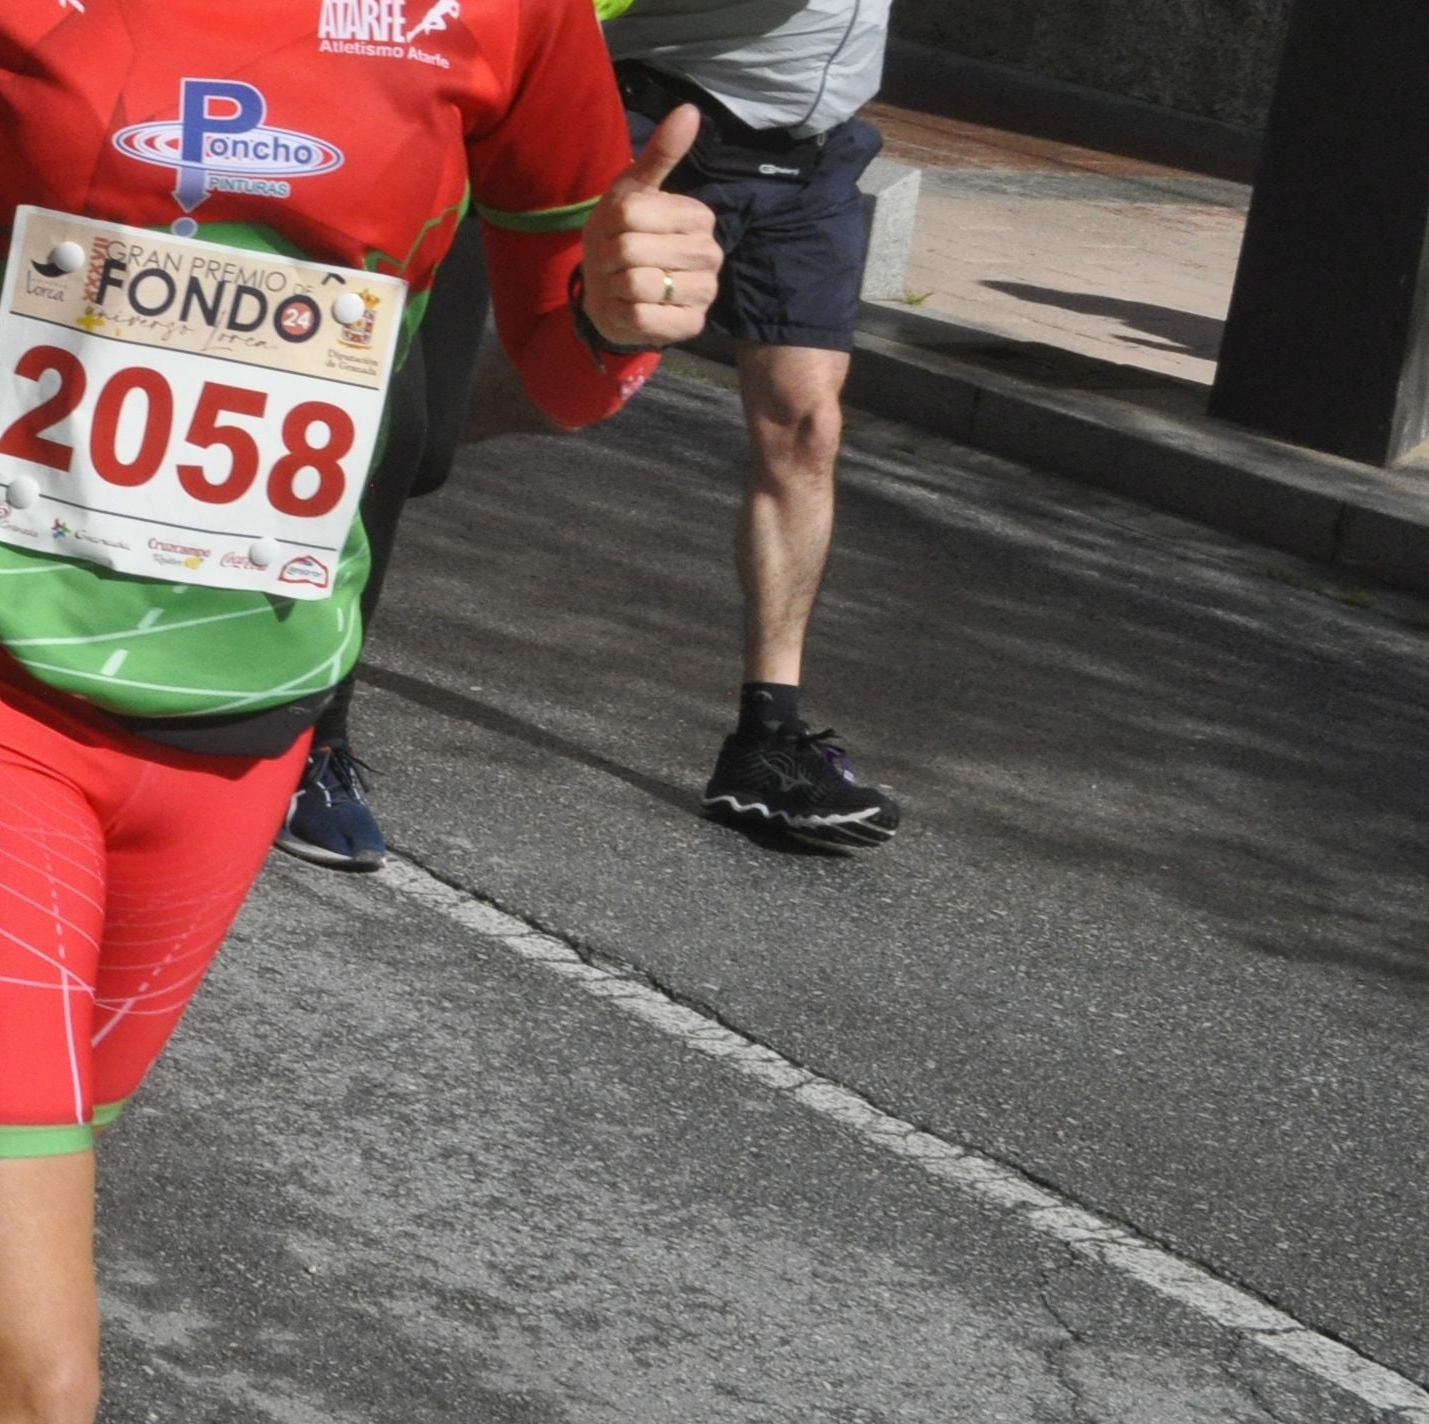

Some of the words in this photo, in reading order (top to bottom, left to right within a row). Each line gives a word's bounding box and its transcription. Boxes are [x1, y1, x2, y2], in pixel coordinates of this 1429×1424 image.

[319, 39, 404, 59] Atletismo
[407, 47, 450, 69] Atarfe
[207, 175, 290, 198] PINTURAS
[106, 239, 184, 273] GRAN
[189, 256, 288, 293] PREMIO
[94, 258, 322, 344] FONDO
[281, 308, 312, 330] 24
